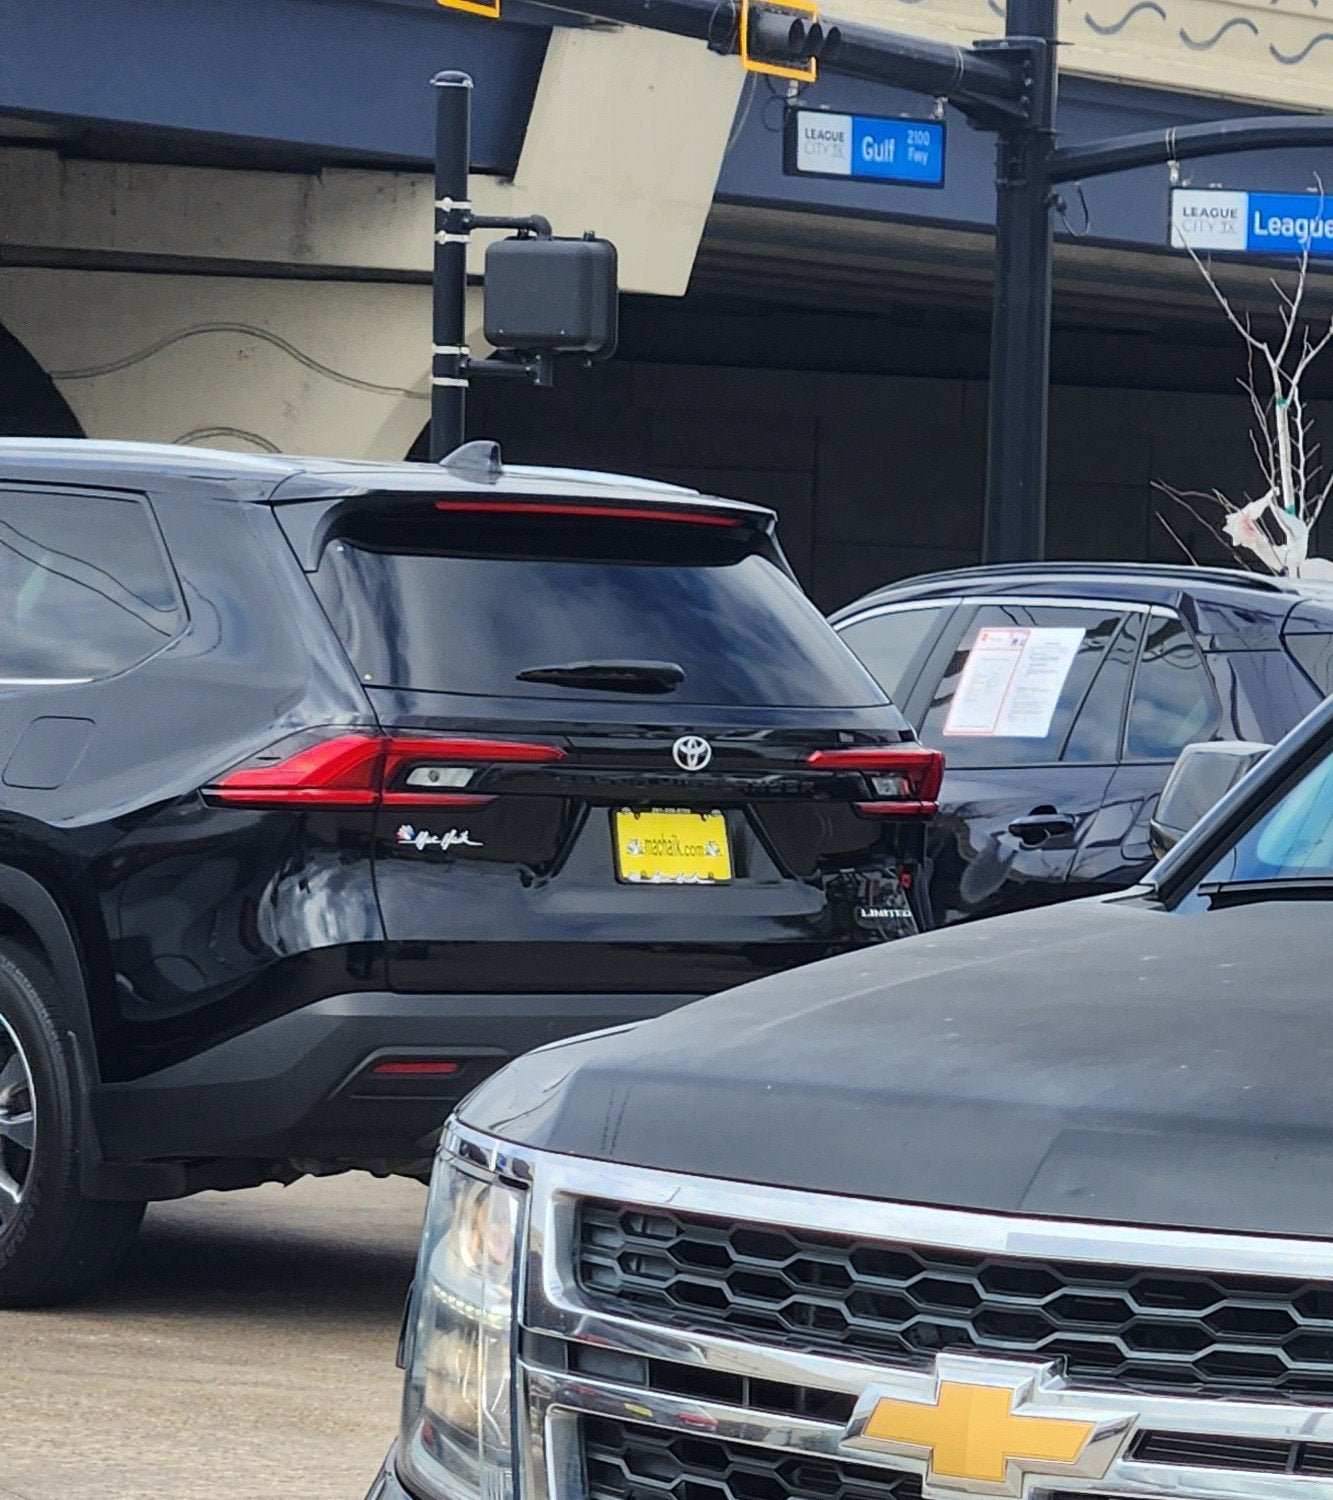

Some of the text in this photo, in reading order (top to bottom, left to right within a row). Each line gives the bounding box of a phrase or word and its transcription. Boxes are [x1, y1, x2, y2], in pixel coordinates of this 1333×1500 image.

[804, 128, 845, 142] LEAGUE
[907, 129, 930, 146] 2100
[862, 135, 895, 163] Gulf
[907, 147, 929, 166] Fwy
[1182, 206, 1238, 219] LEAGUE
[1182, 220, 1214, 234] CITY
